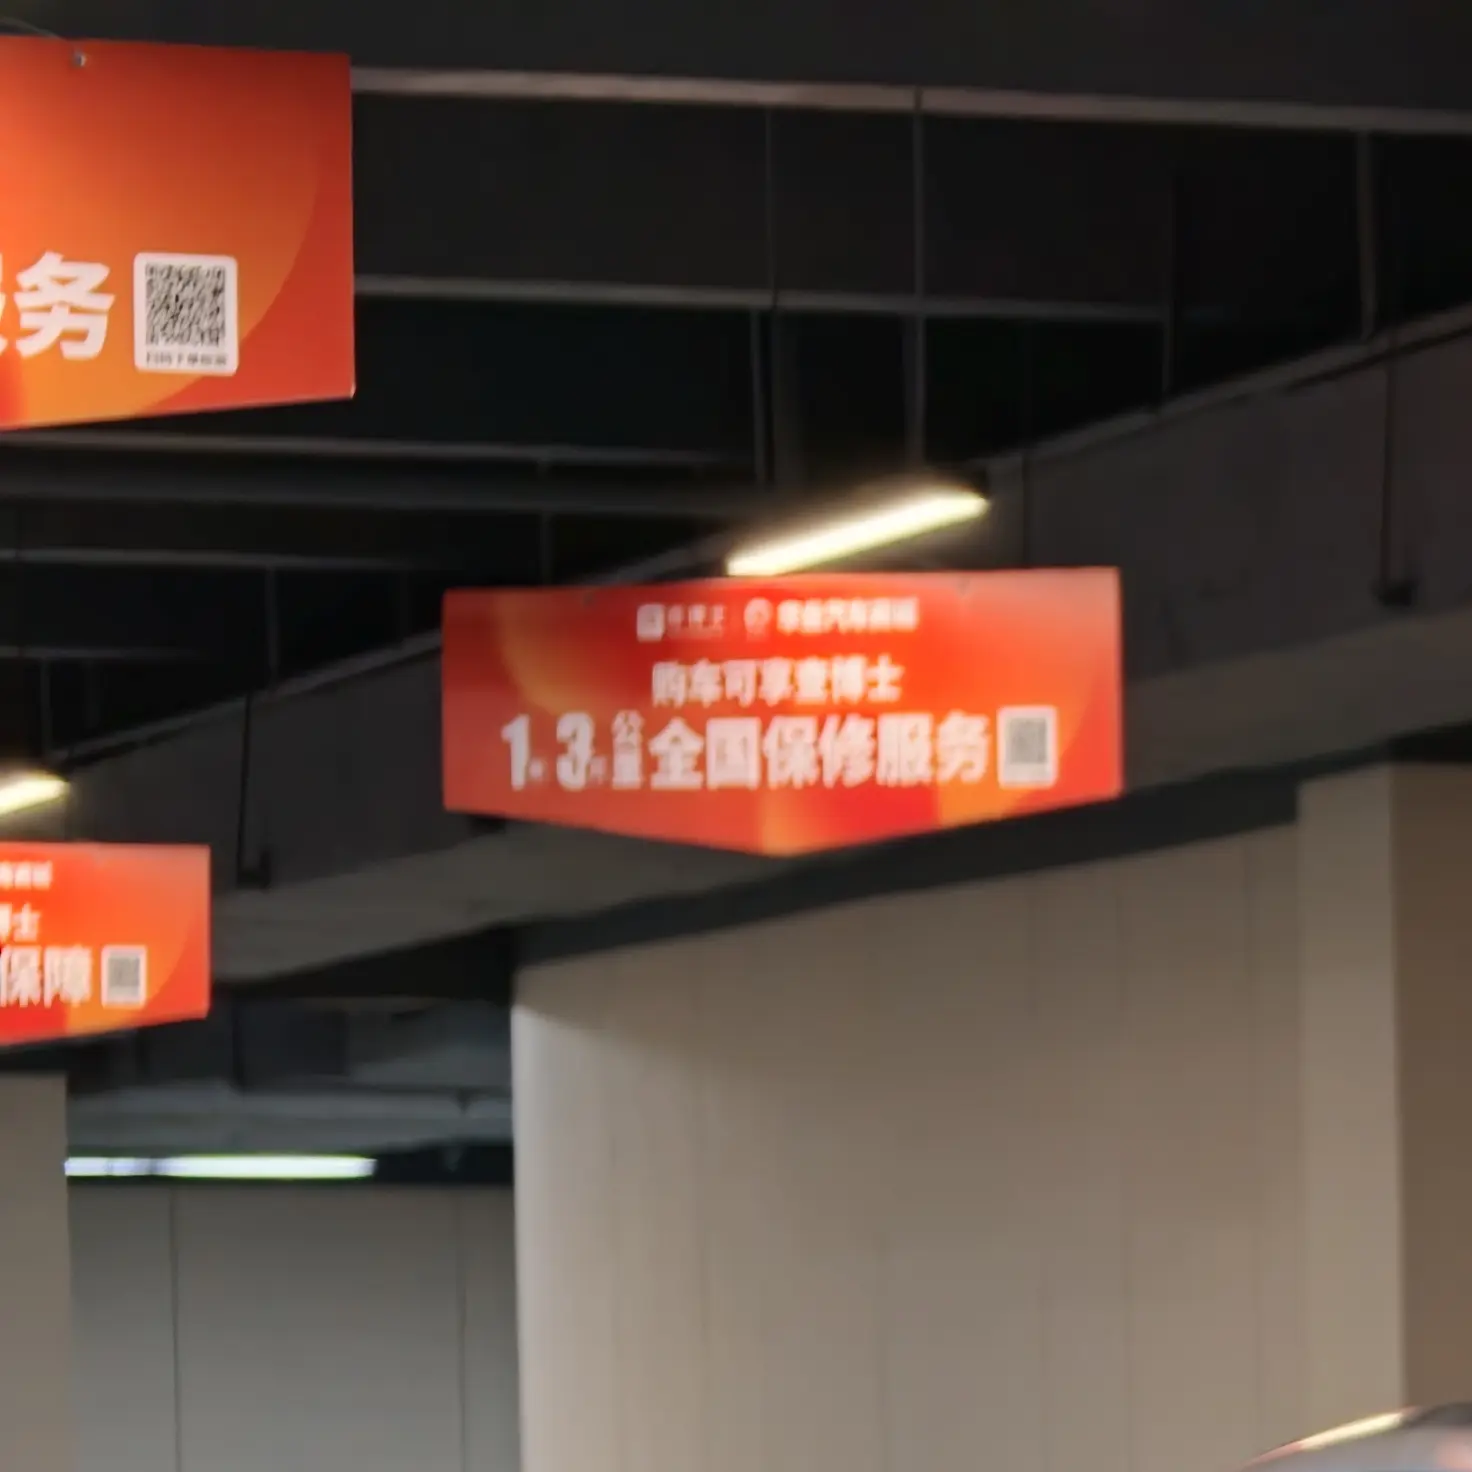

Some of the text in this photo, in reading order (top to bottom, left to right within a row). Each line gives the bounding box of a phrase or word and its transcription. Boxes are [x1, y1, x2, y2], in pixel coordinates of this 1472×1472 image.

[0, 250, 116, 360] 务
[651, 653, 905, 708] 购车可享查博士
